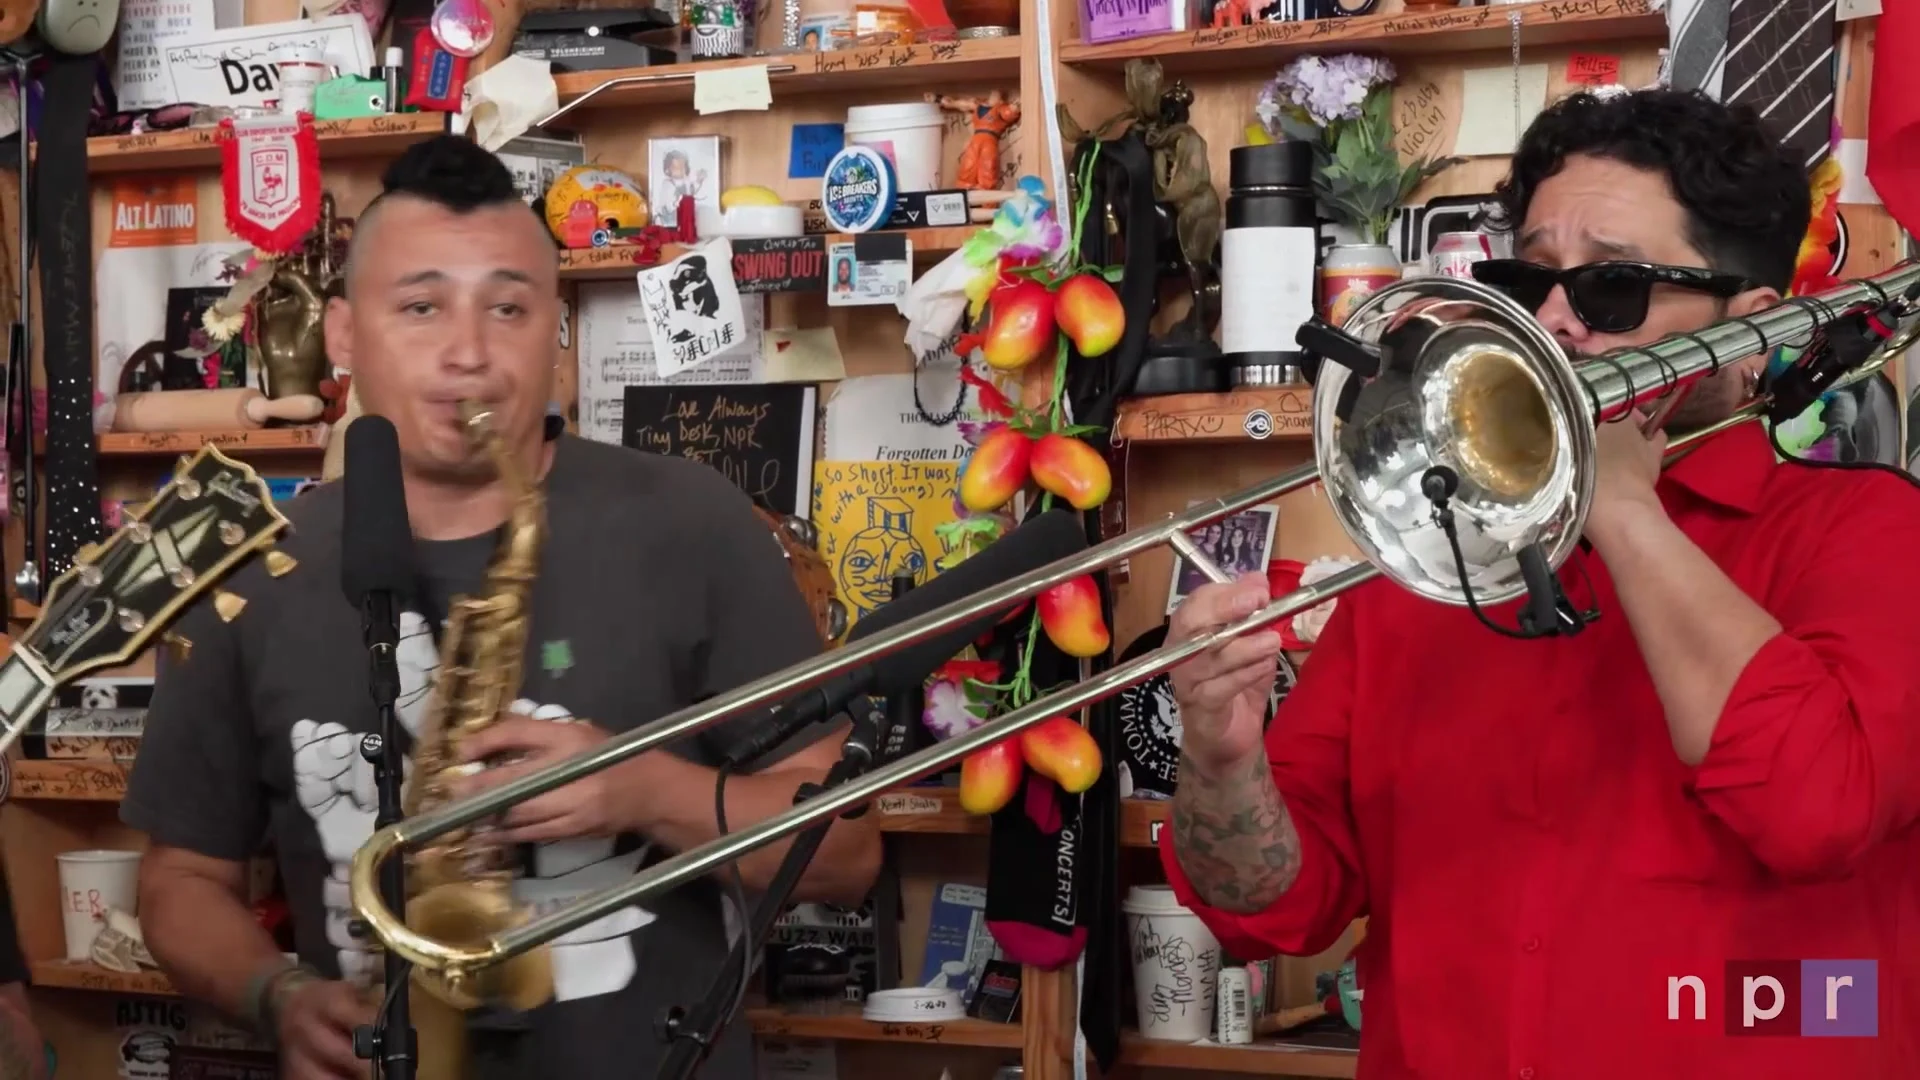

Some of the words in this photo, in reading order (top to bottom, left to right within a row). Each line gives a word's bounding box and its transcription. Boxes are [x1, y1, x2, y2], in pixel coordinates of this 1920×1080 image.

[842, 178, 878, 199] BREAKERS
[116, 204, 142, 229] ALT
[144, 203, 194, 229] LATINO
[734, 252, 787, 281] SWING
[791, 251, 823, 278] OUT
[636, 426, 671, 455] Tiny
[876, 445, 947, 463] Forgotten
